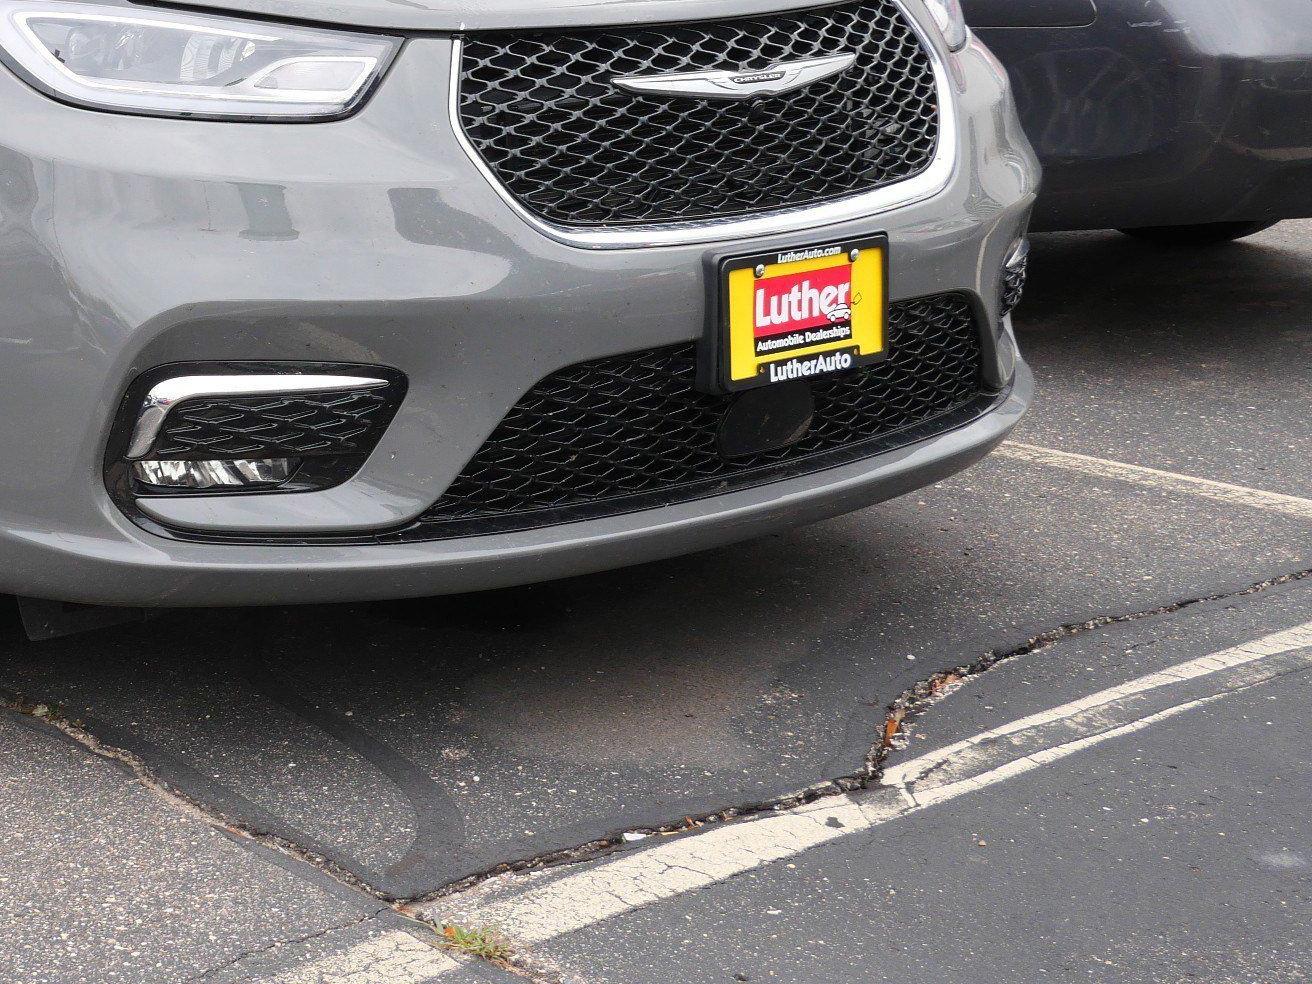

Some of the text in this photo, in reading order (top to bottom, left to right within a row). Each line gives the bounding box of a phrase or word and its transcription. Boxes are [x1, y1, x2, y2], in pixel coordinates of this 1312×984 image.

[733, 73, 781, 82] CHRYSLER
[777, 246, 841, 264] LutherAuto.com
[755, 280, 851, 328] Luther
[757, 325, 851, 352] Automobile Dealerships
[770, 352, 851, 383] LutherAuto
